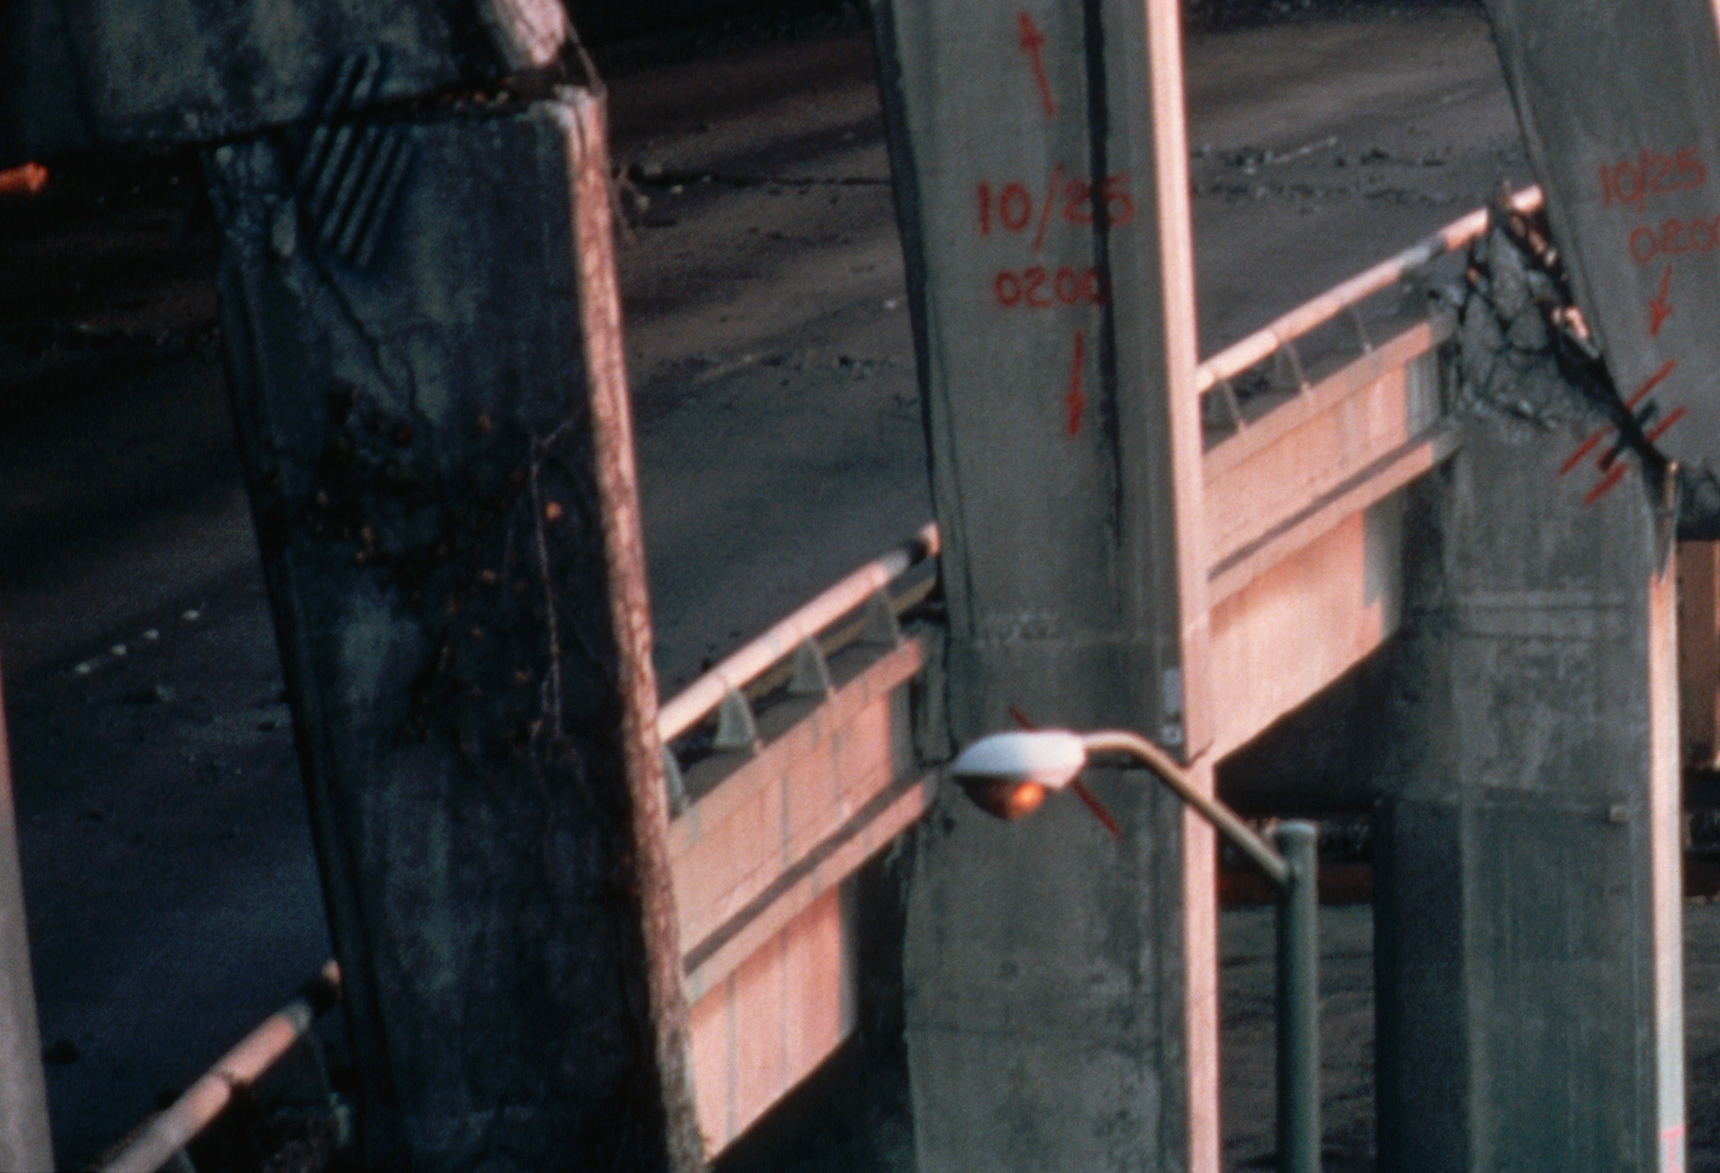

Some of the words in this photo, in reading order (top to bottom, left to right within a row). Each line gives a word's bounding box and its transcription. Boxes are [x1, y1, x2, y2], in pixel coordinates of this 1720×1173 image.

[976, 163, 1136, 256] 10/25
[1599, 146, 1706, 214] 10/25
[994, 266, 1112, 308] 0200
